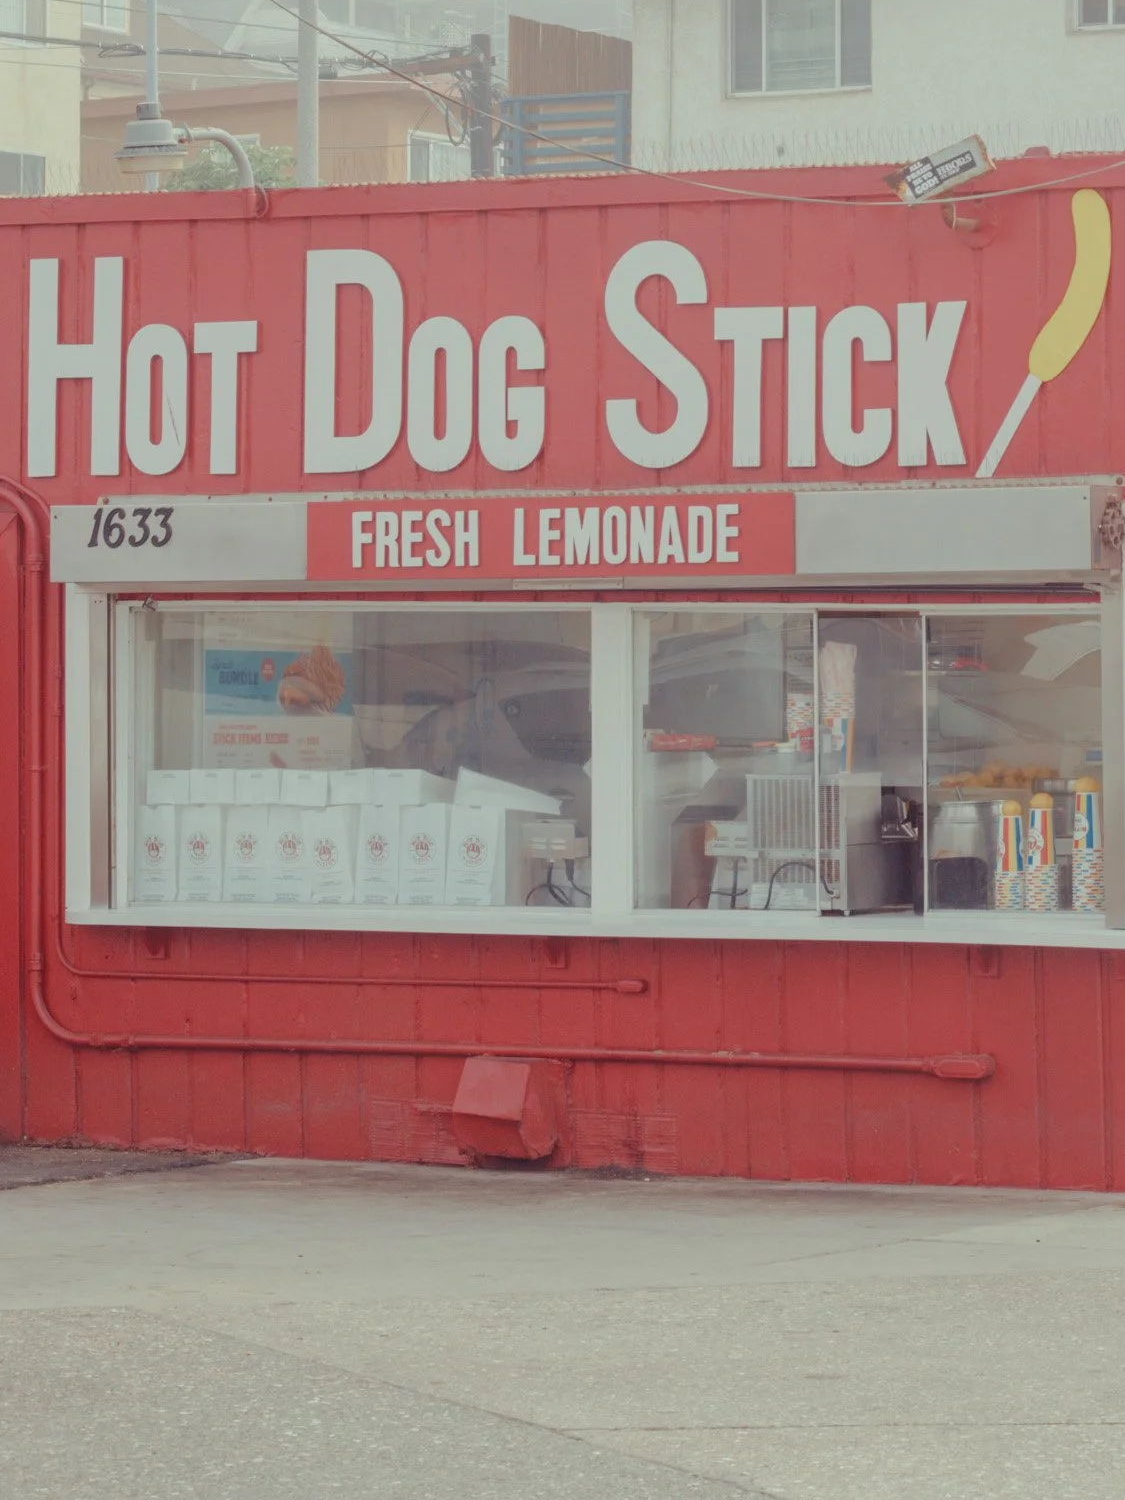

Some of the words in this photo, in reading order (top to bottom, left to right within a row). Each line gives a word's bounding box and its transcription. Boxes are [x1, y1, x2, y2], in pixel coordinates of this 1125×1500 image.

[915, 176, 940, 194] GOD!
[28, 256, 258, 477] HOT
[303, 249, 545, 474] DOG
[604, 240, 967, 469] STICK
[87, 506, 175, 549] 1633
[351, 509, 480, 569] FRESH
[513, 503, 740, 567] LEMONADE
